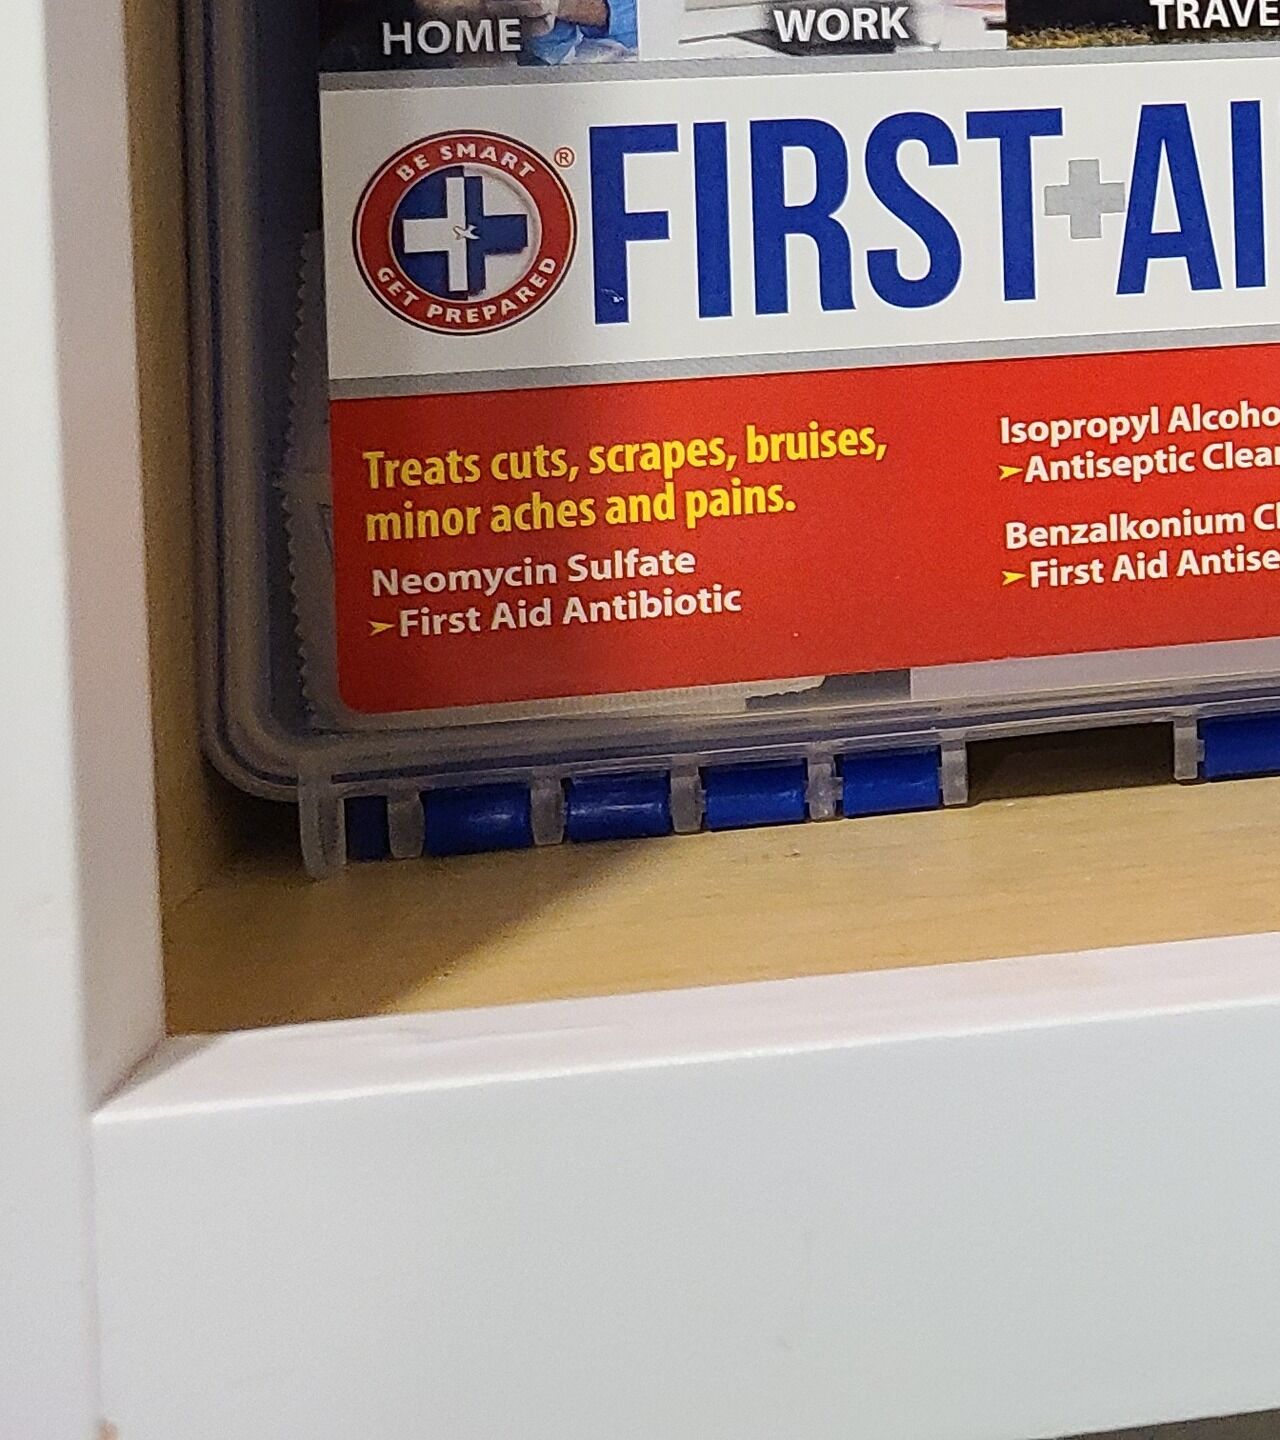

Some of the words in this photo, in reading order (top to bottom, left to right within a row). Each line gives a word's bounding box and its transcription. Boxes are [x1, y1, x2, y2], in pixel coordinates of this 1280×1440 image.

[382, 18, 522, 55] HOME
[773, 6, 910, 42] WORK
[396, 153, 430, 182] BE
[440, 143, 535, 178] SMART
[589, 106, 1063, 325] FIRST
[377, 266, 419, 307] GET
[426, 258, 557, 324] PREPARED
[1000, 406, 1160, 447] Isopropyl
[363, 449, 481, 489] Treats
[491, 442, 580, 482] cuts,
[588, 433, 738, 479] scrapes,
[746, 421, 887, 464] bruises,
[1024, 444, 1196, 483] Antiseptic
[366, 500, 480, 542] minor
[490, 491, 596, 535] aches
[605, 482, 675, 526] and
[686, 477, 796, 529] pains.
[1005, 508, 1246, 550] Benzalkonium
[372, 556, 557, 598] Neomycin
[567, 546, 697, 584] Sulfate
[1029, 557, 1104, 589] First
[1111, 550, 1168, 583] Aid
[400, 603, 481, 638] First
[491, 596, 552, 631] Aid
[563, 583, 742, 626] Antibiotic
